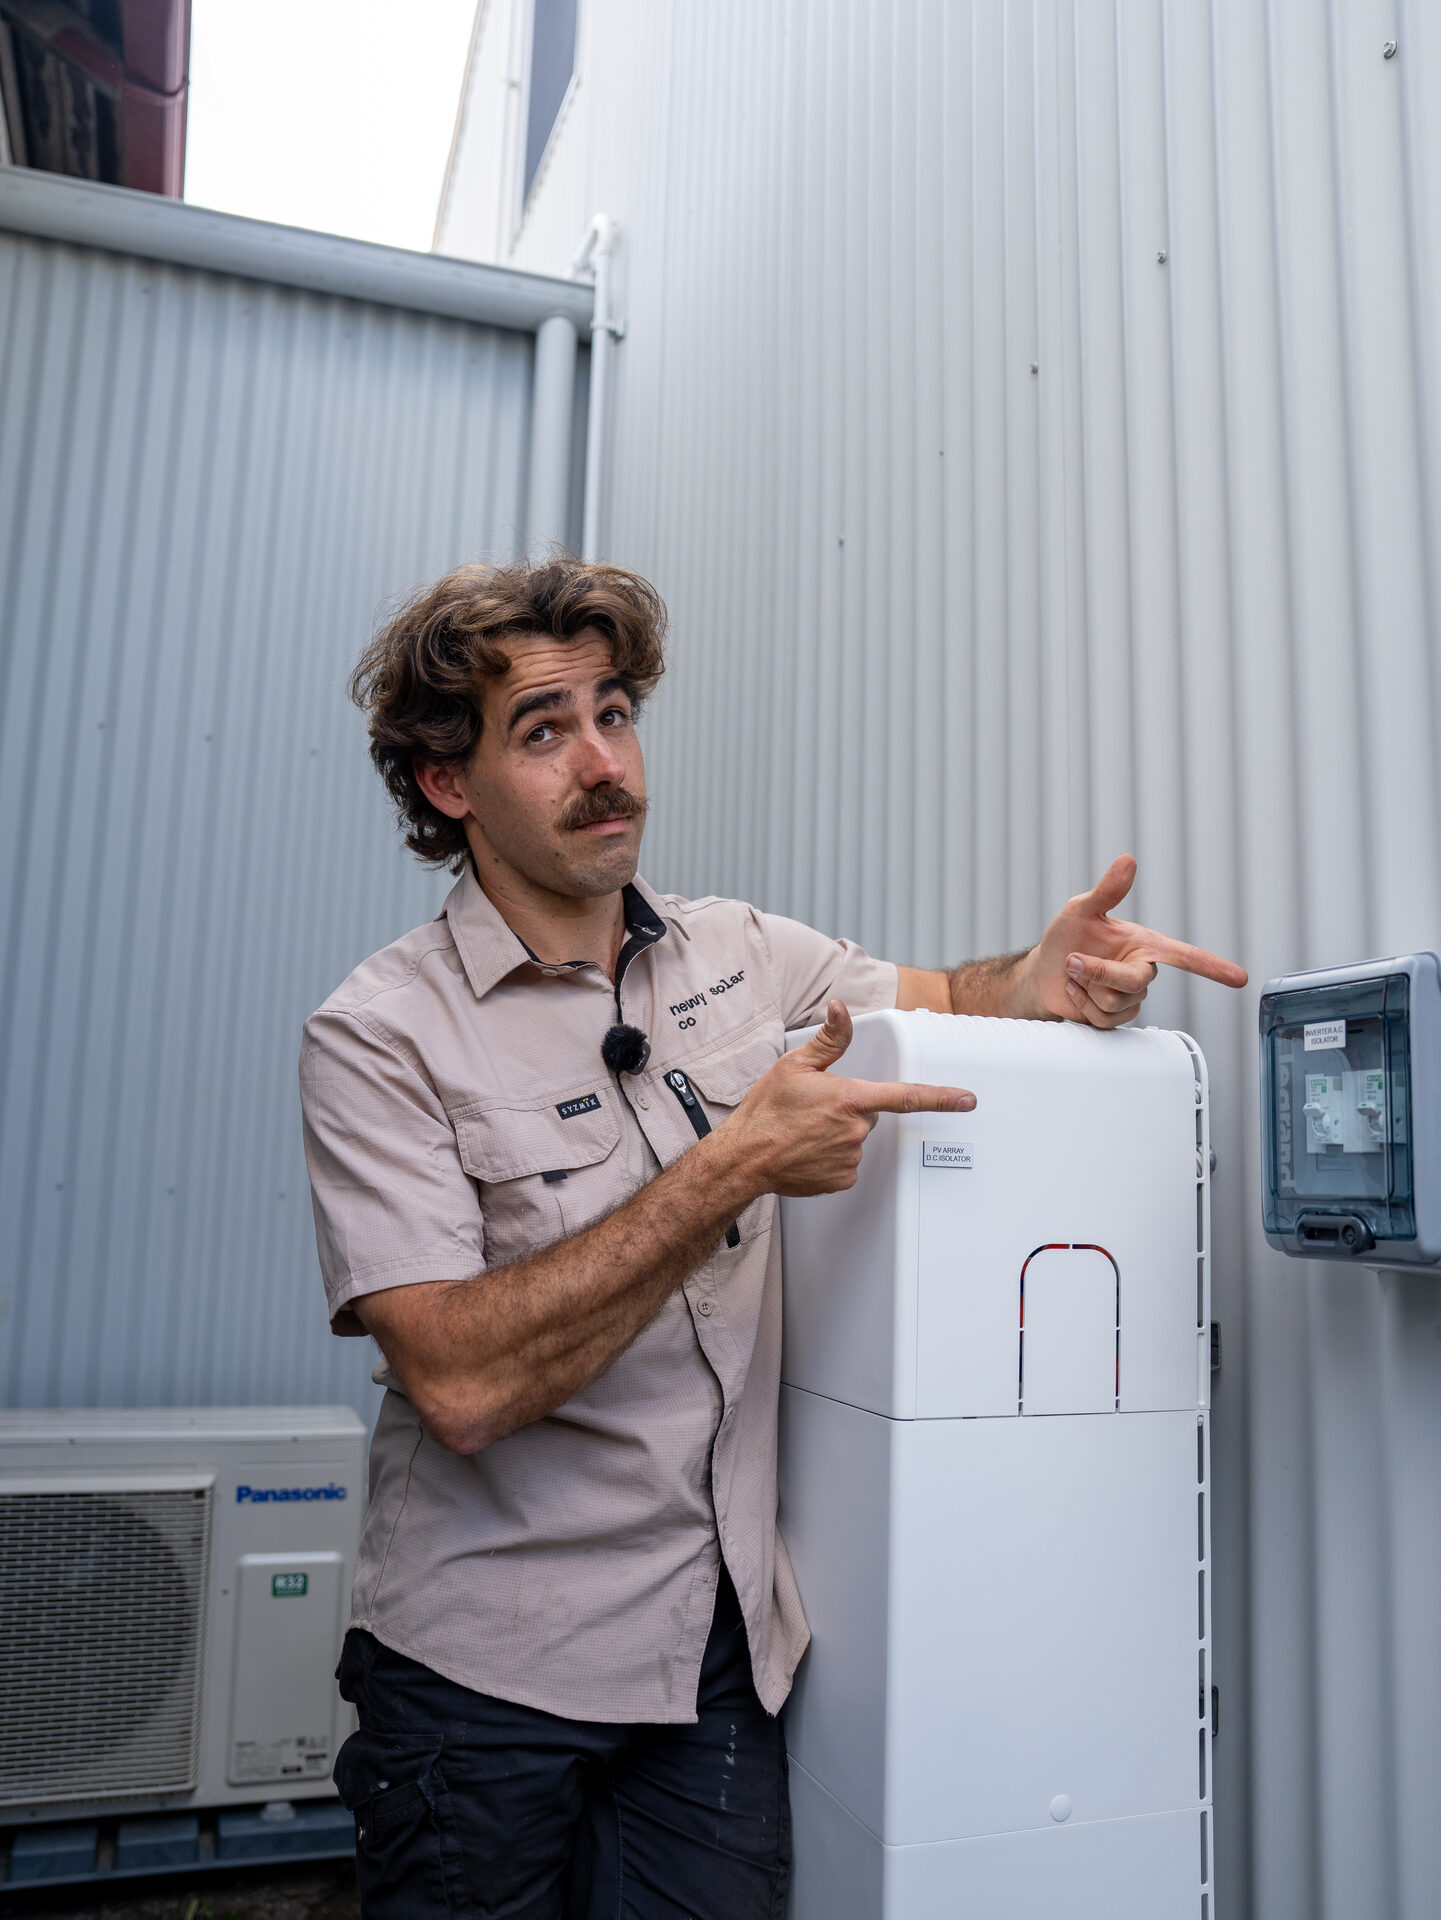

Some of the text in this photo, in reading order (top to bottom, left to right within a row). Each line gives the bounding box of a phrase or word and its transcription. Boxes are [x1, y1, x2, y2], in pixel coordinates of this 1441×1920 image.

[669, 970, 745, 1016] newy solar
[678, 1016, 697, 1030] co
[1310, 1035, 1338, 1045] ISOLATOR
[561, 1098, 597, 1115] SYZMIK
[236, 1481, 347, 1503] Panasonic
